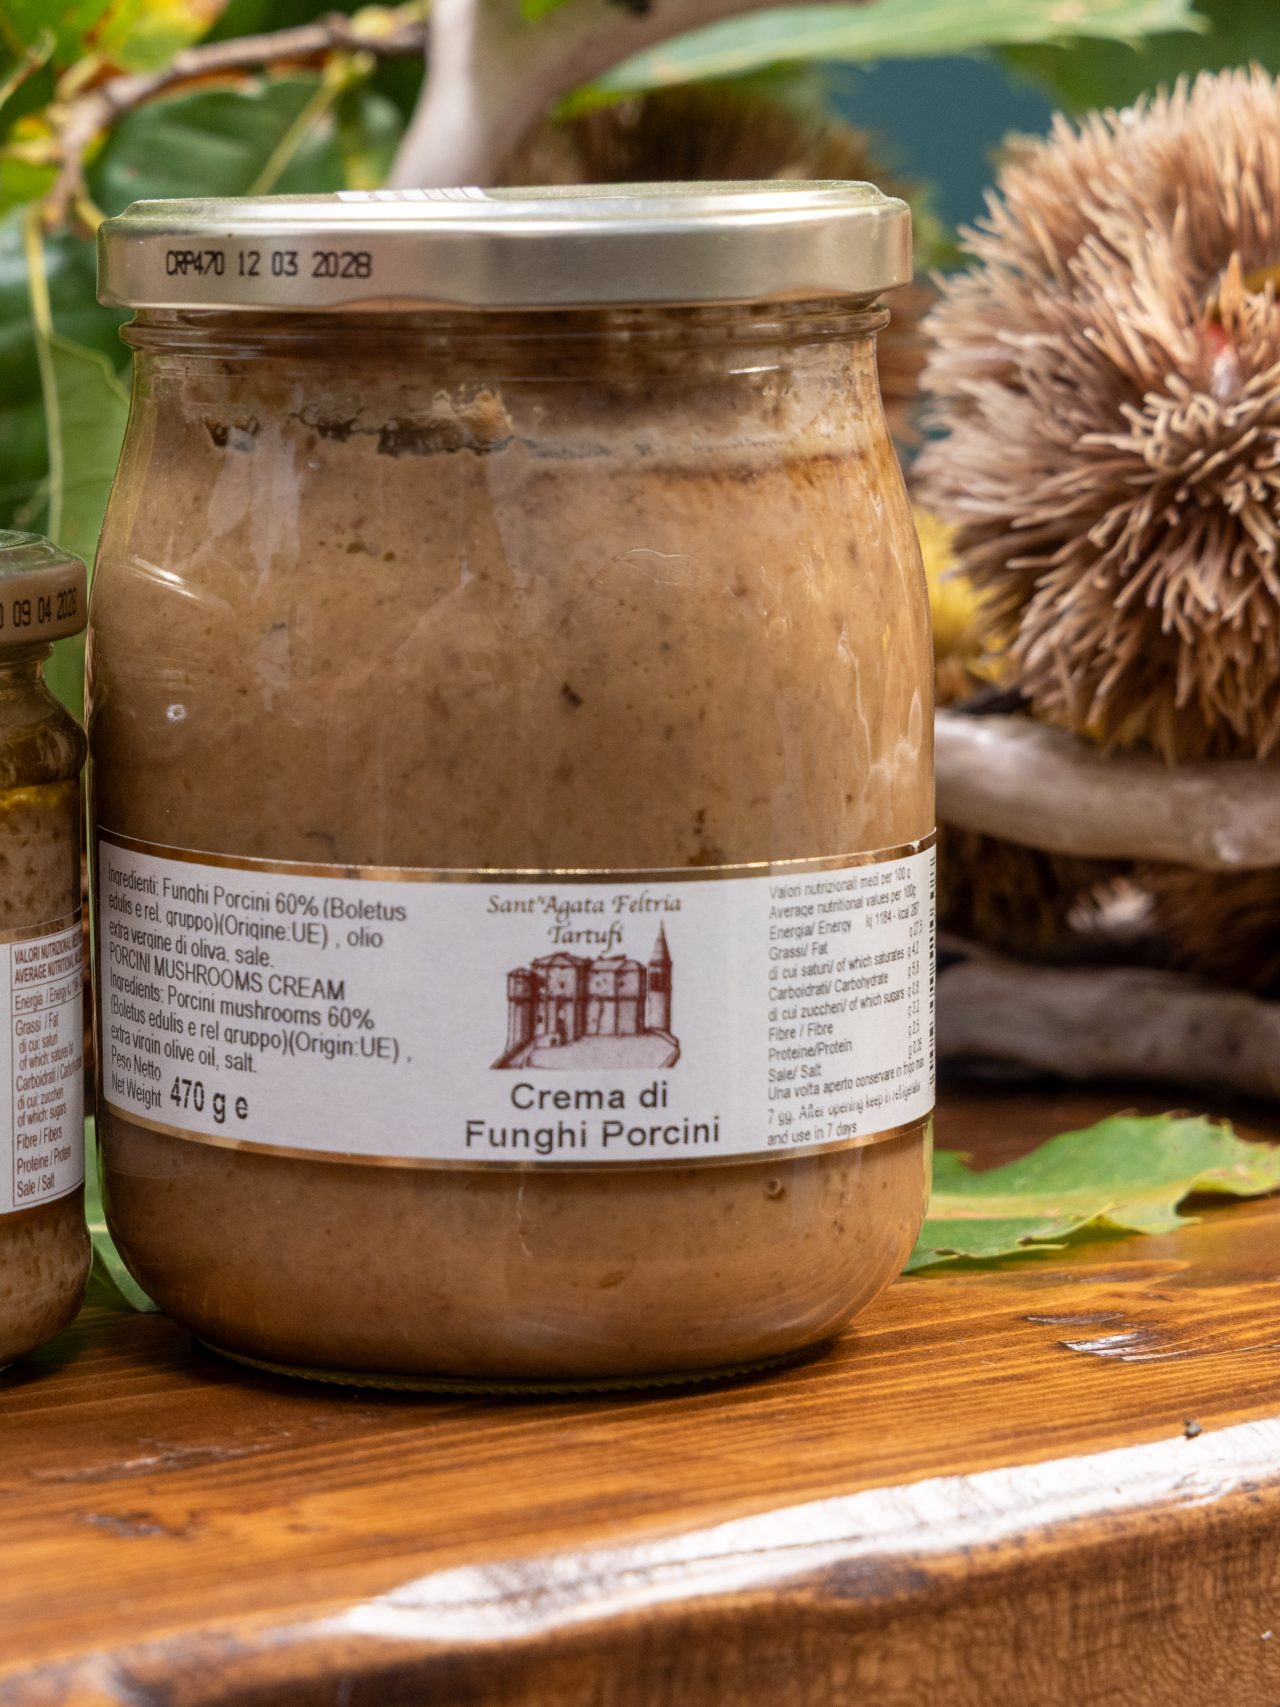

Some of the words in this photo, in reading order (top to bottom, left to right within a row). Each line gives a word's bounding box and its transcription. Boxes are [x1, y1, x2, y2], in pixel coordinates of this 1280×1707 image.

[166, 250, 225, 276] CRP470
[238, 251, 260, 277] 12
[272, 251, 299, 277] 03
[312, 251, 373, 280] 2028
[13, 600, 31, 627] 09
[37, 597, 52, 624] 04
[108, 862, 159, 897] Ingredienti:
[163, 878, 209, 906] Funghi
[214, 886, 270, 913] Porcini
[276, 891, 319, 918] 60%
[323, 896, 407, 922] (Boletus
[612, 889, 682, 914] Feltria
[109, 892, 132, 917] edulis
[136, 904, 142, 919] e
[145, 901, 161, 923] rel.
[347, 927, 384, 949] olio
[109, 919, 129, 941] extra
[132, 927, 172, 952] vergine
[175, 934, 187, 954] di
[235, 947, 274, 968] sale.
[547, 920, 623, 952] Tartufi
[811, 941, 829, 957] Fat
[14, 946, 40, 966] VALORI
[109, 941, 151, 974] PORCINI
[154, 956, 263, 993] MUSHROOMS
[268, 974, 346, 1001] CREAM
[14, 963, 47, 985] AVERAGE
[15, 991, 43, 1012] Energia
[110, 966, 164, 1001] Ingredients:
[168, 986, 215, 1013] Porcini
[220, 1000, 321, 1026] mushrooms
[327, 1005, 375, 1030] 60%
[15, 1016, 41, 1037] Grassi
[48, 1010, 59, 1029] Fat
[110, 993, 145, 1025] (Boletus
[149, 1008, 184, 1036] edulis
[188, 1020, 197, 1036] e
[201, 1017, 219, 1041] rel
[768, 1026, 796, 1042] Fibre
[807, 1021, 833, 1038] Fibre
[111, 1022, 131, 1046] extra
[133, 1029, 161, 1056] virgin
[164, 1035, 194, 1063] olive
[199, 1045, 220, 1071] oil,
[225, 1050, 257, 1074] salt.
[112, 1045, 131, 1074] Peso
[134, 1054, 161, 1082] Netto
[112, 1071, 125, 1094] Net
[127, 1076, 161, 1110] Weight
[170, 1076, 205, 1112] 470
[212, 1091, 226, 1123] g
[510, 1082, 626, 1110] Crema
[639, 1080, 668, 1109] di
[823, 1077, 853, 1096] aperto
[17, 1132, 38, 1151] Fibre
[43, 1125, 63, 1144] Fibers
[465, 1120, 587, 1156] Funghi
[602, 1115, 720, 1148] Porcini
[768, 1130, 789, 1147] and
[792, 1127, 811, 1143] use
[17, 1153, 49, 1175] Proteine
[17, 1177, 36, 1198] Sale
[42, 1171, 55, 1191] Salt
